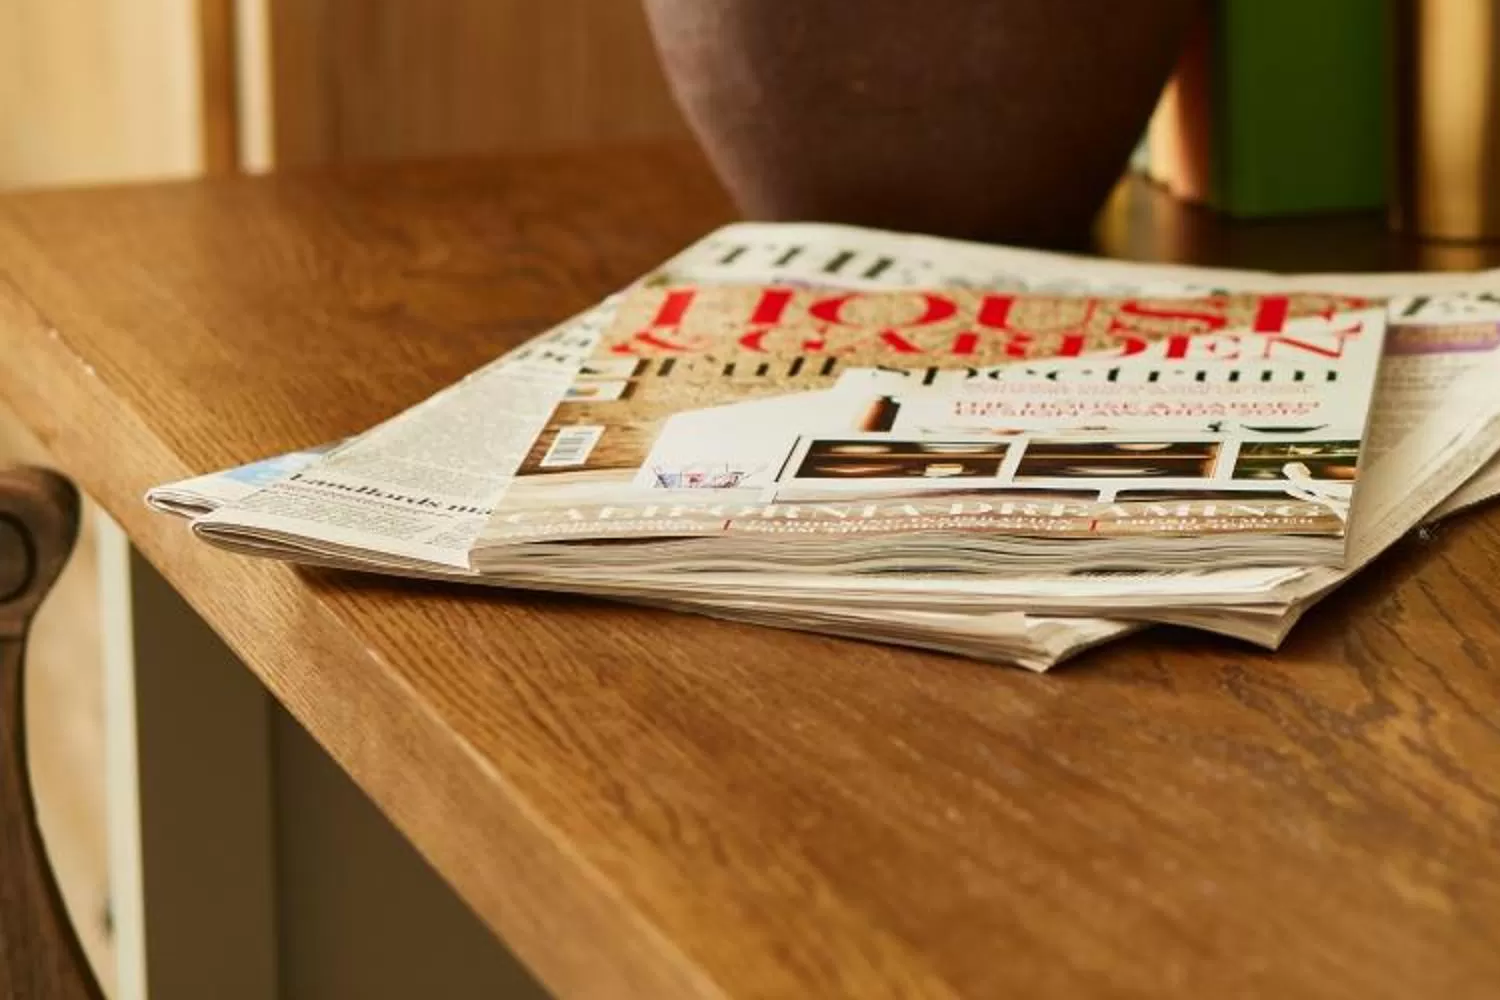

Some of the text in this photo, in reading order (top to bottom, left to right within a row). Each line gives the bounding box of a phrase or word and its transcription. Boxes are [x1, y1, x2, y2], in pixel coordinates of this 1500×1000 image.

[643, 288, 1369, 334] HOUSE
[736, 326, 1349, 361] GARDEN
[650, 356, 1342, 387] Full spectrum
[288, 473, 442, 508] Landlords
[500, 502, 1320, 525] CALIFORNIA DREAMING
